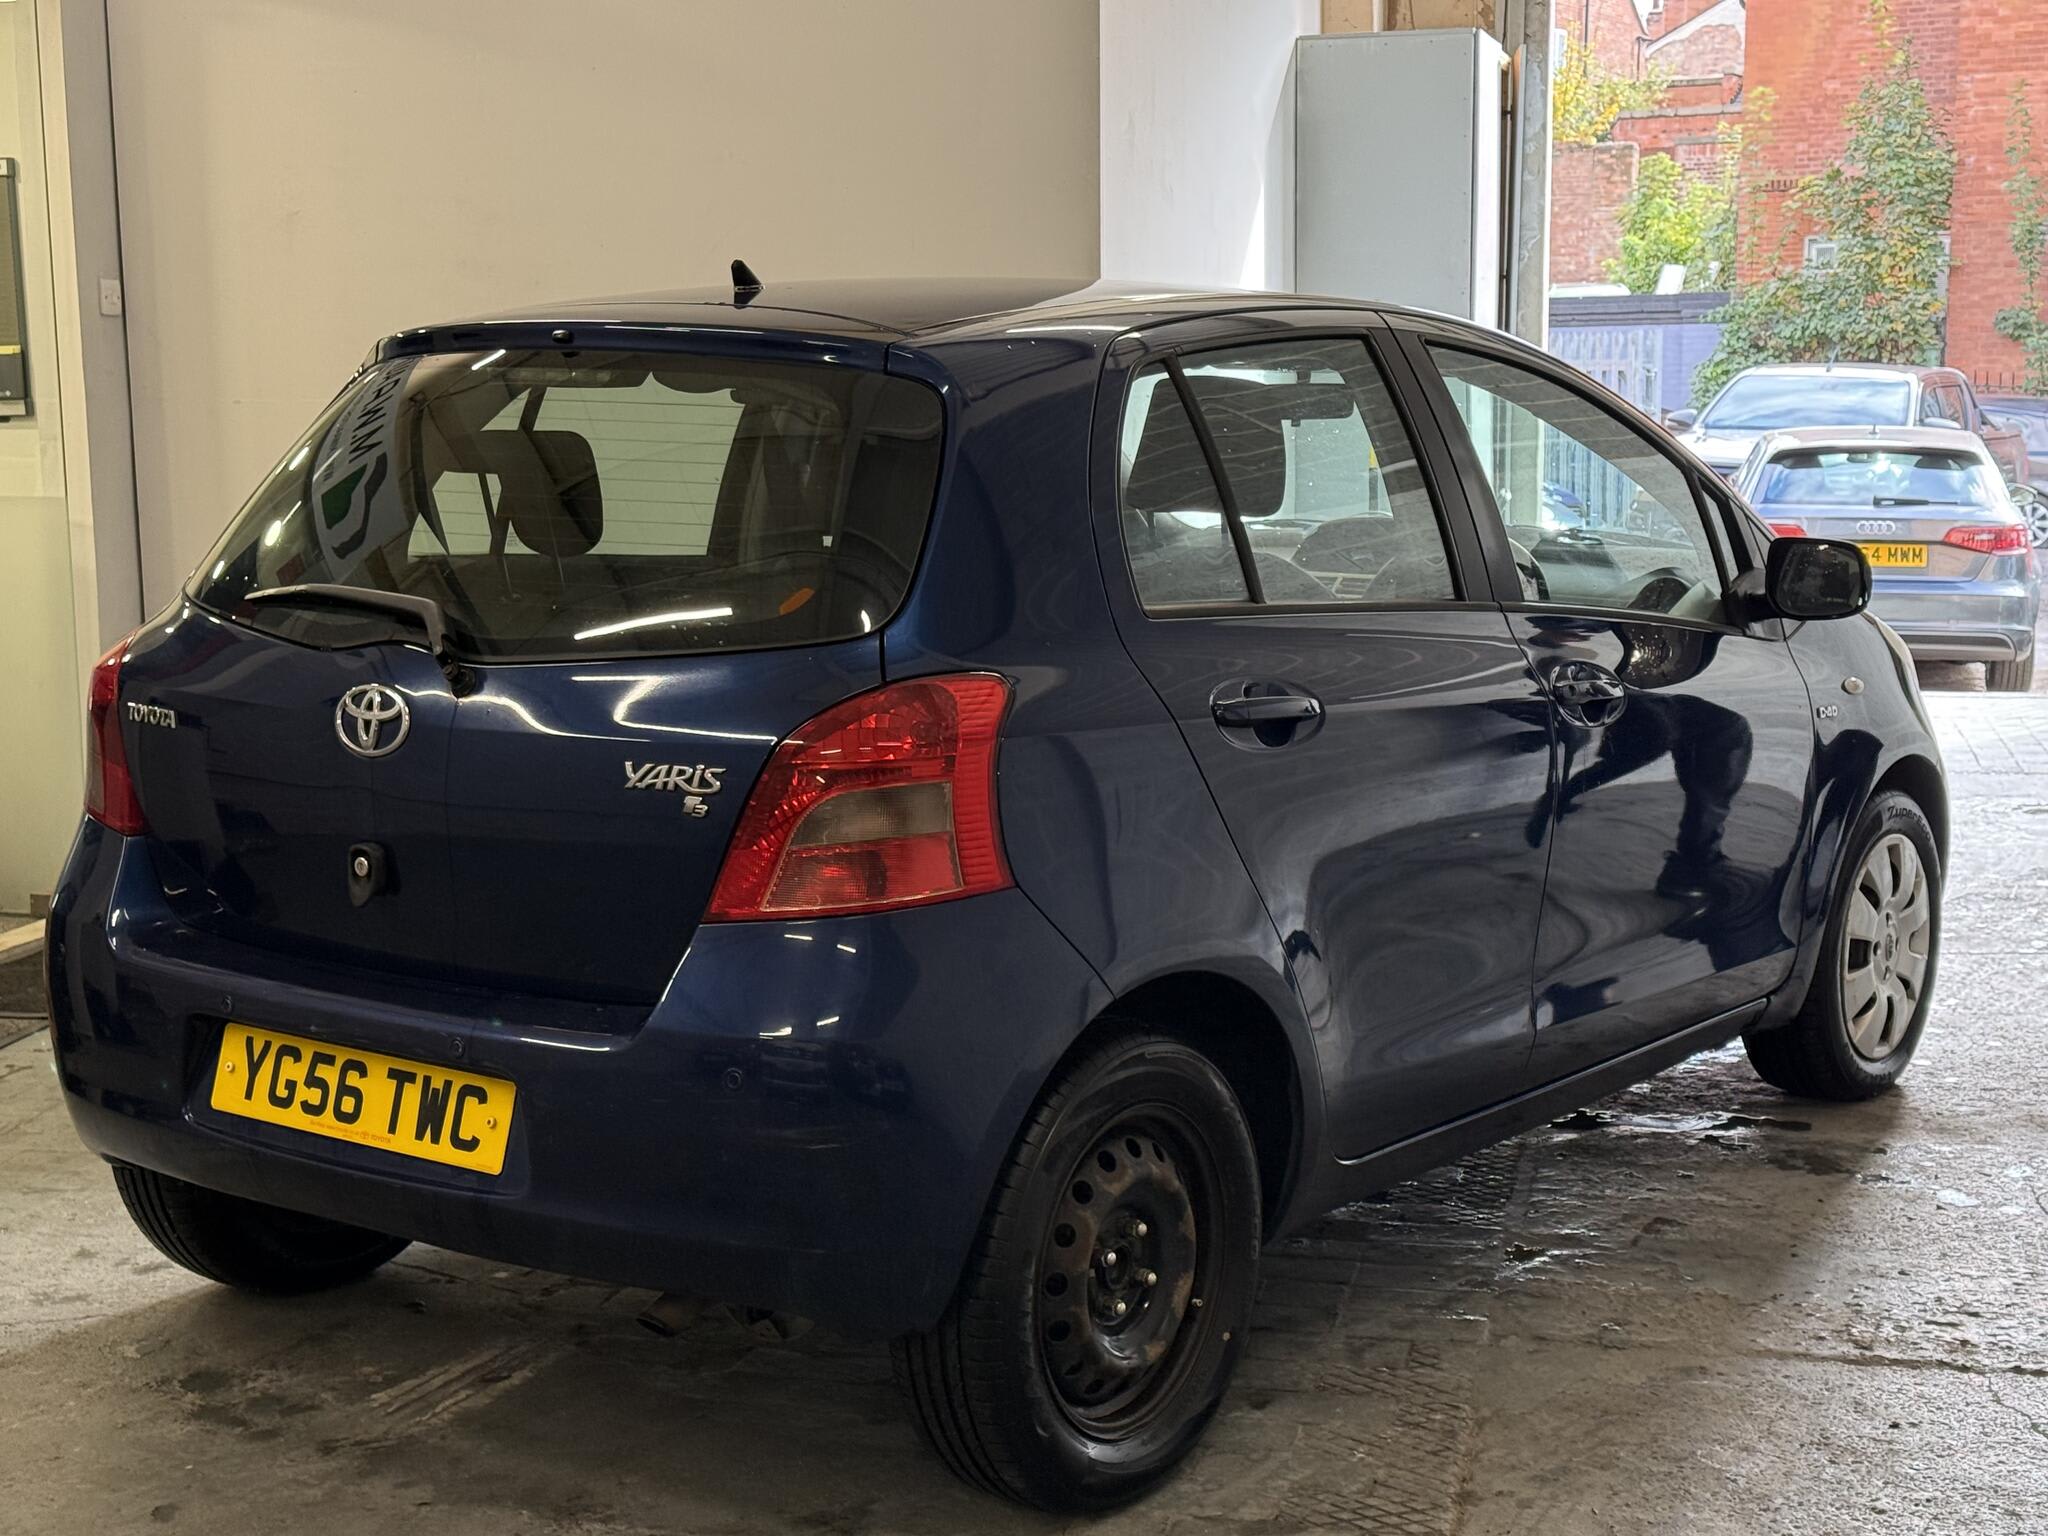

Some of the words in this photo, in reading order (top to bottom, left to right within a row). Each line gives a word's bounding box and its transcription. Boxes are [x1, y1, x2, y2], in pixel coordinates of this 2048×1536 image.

[1887, 546, 1923, 563] MWM
[127, 702, 176, 729] TOYOTA
[243, 1035, 369, 1126] YG56
[386, 1066, 489, 1153] TWC
